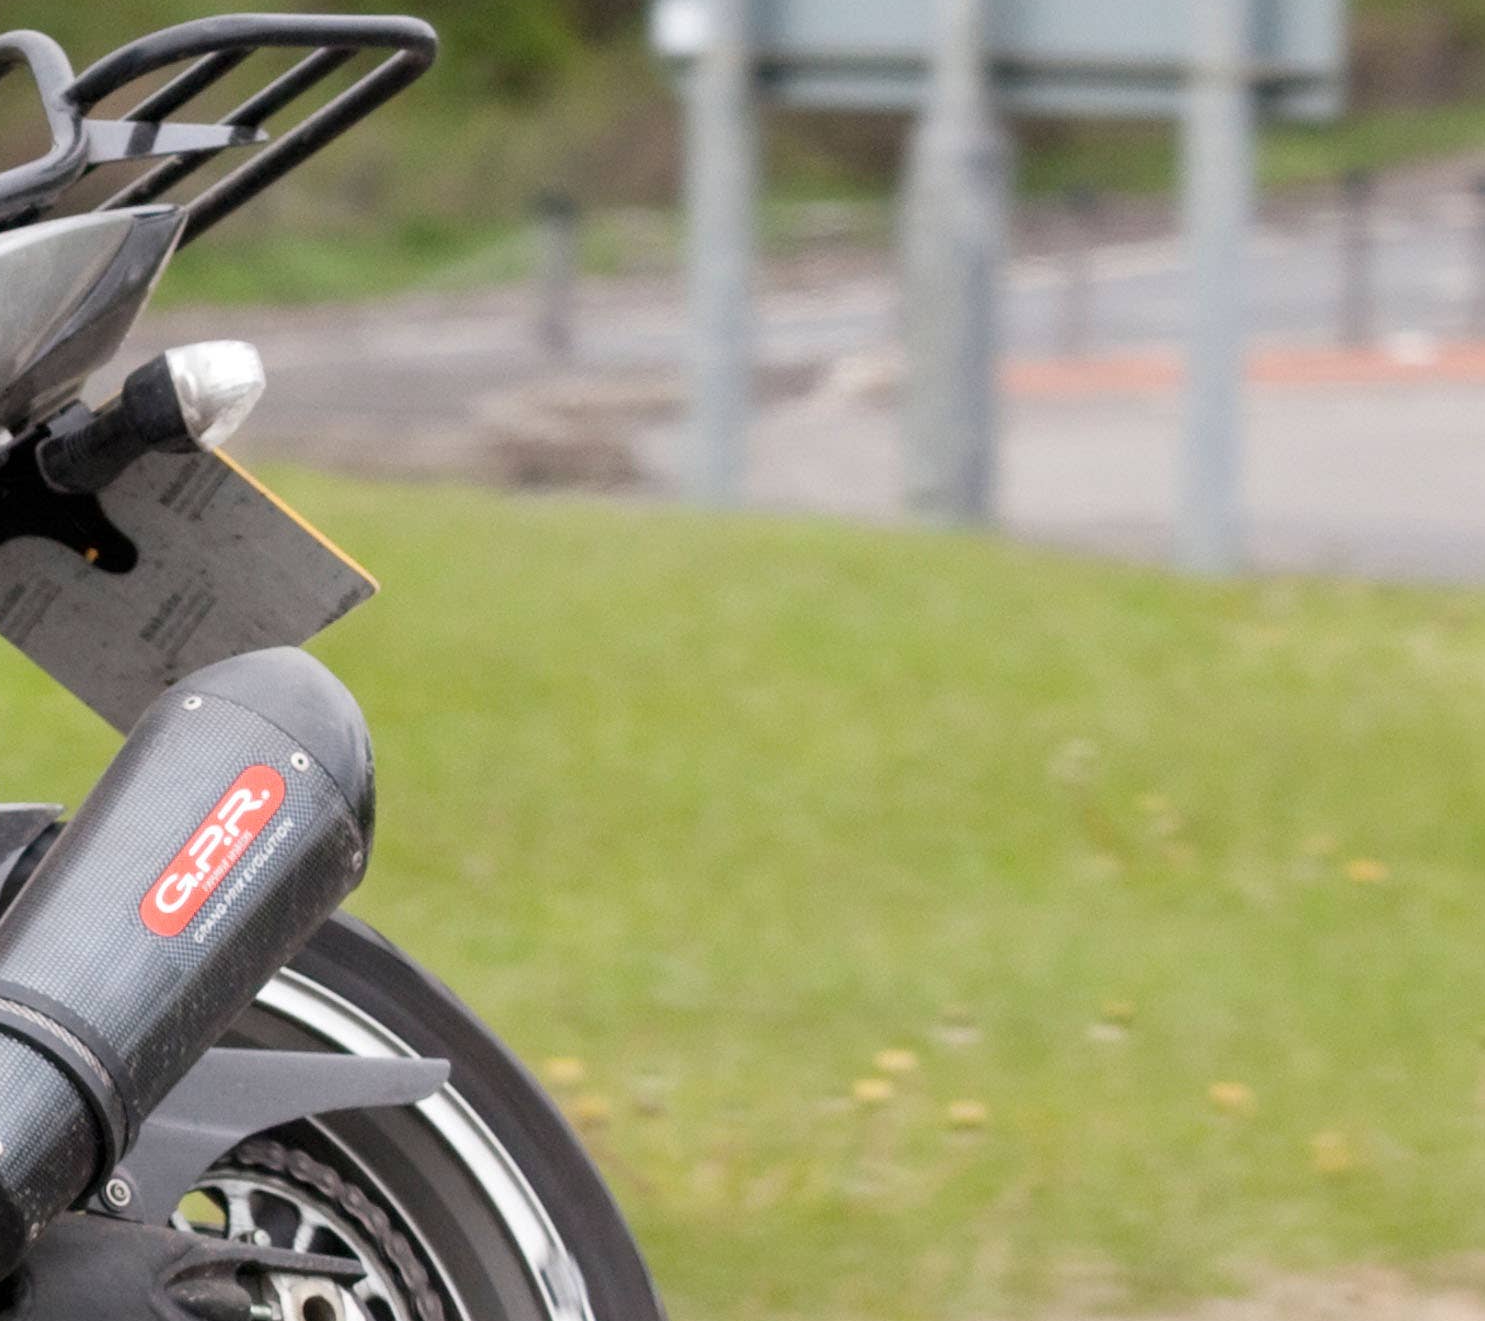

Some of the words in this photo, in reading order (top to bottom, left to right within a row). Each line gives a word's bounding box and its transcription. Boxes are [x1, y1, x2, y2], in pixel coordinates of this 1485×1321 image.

[193, 901, 228, 944] GRAND
[222, 879, 246, 905] PRIX
[243, 816, 294, 881] EVOLUTION
